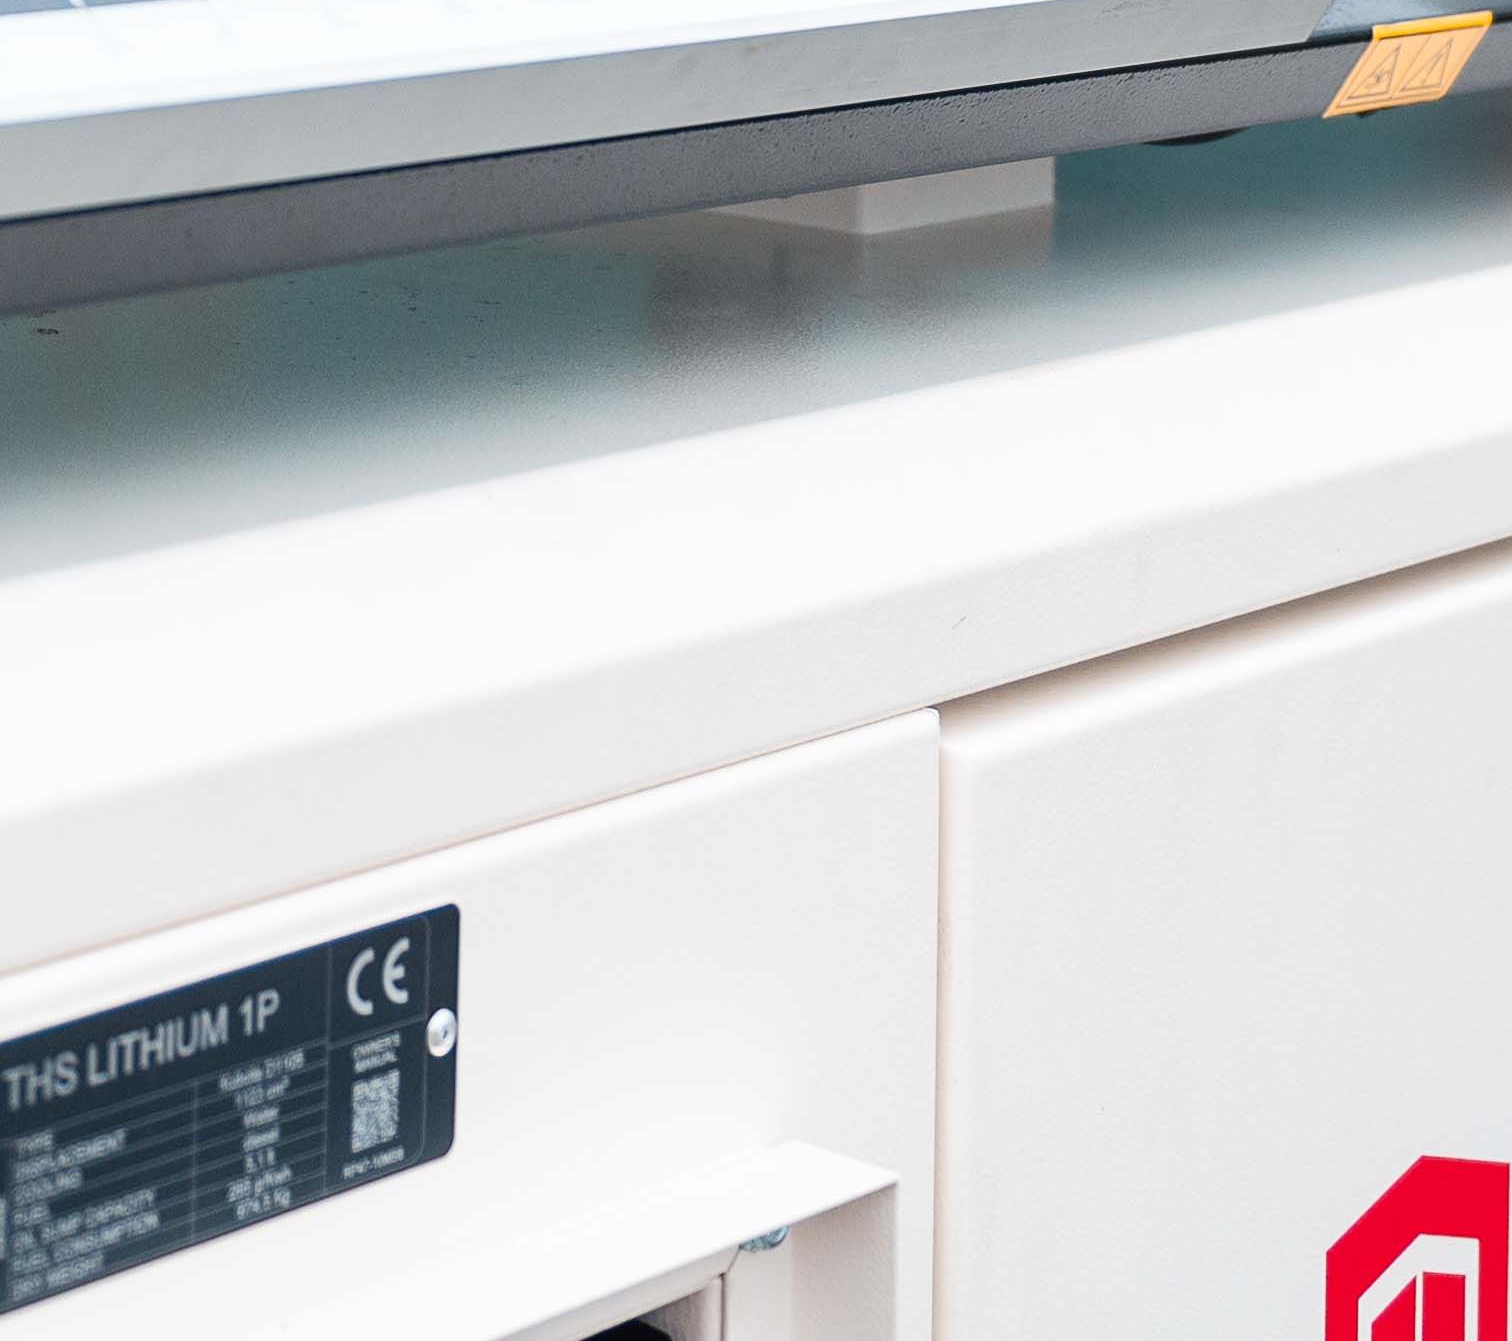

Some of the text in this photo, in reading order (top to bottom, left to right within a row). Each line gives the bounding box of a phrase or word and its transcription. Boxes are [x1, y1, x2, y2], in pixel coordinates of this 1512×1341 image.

[3, 1050, 78, 1112] THS
[86, 1003, 229, 1086] LITHIUM
[238, 987, 281, 1037] 1P
